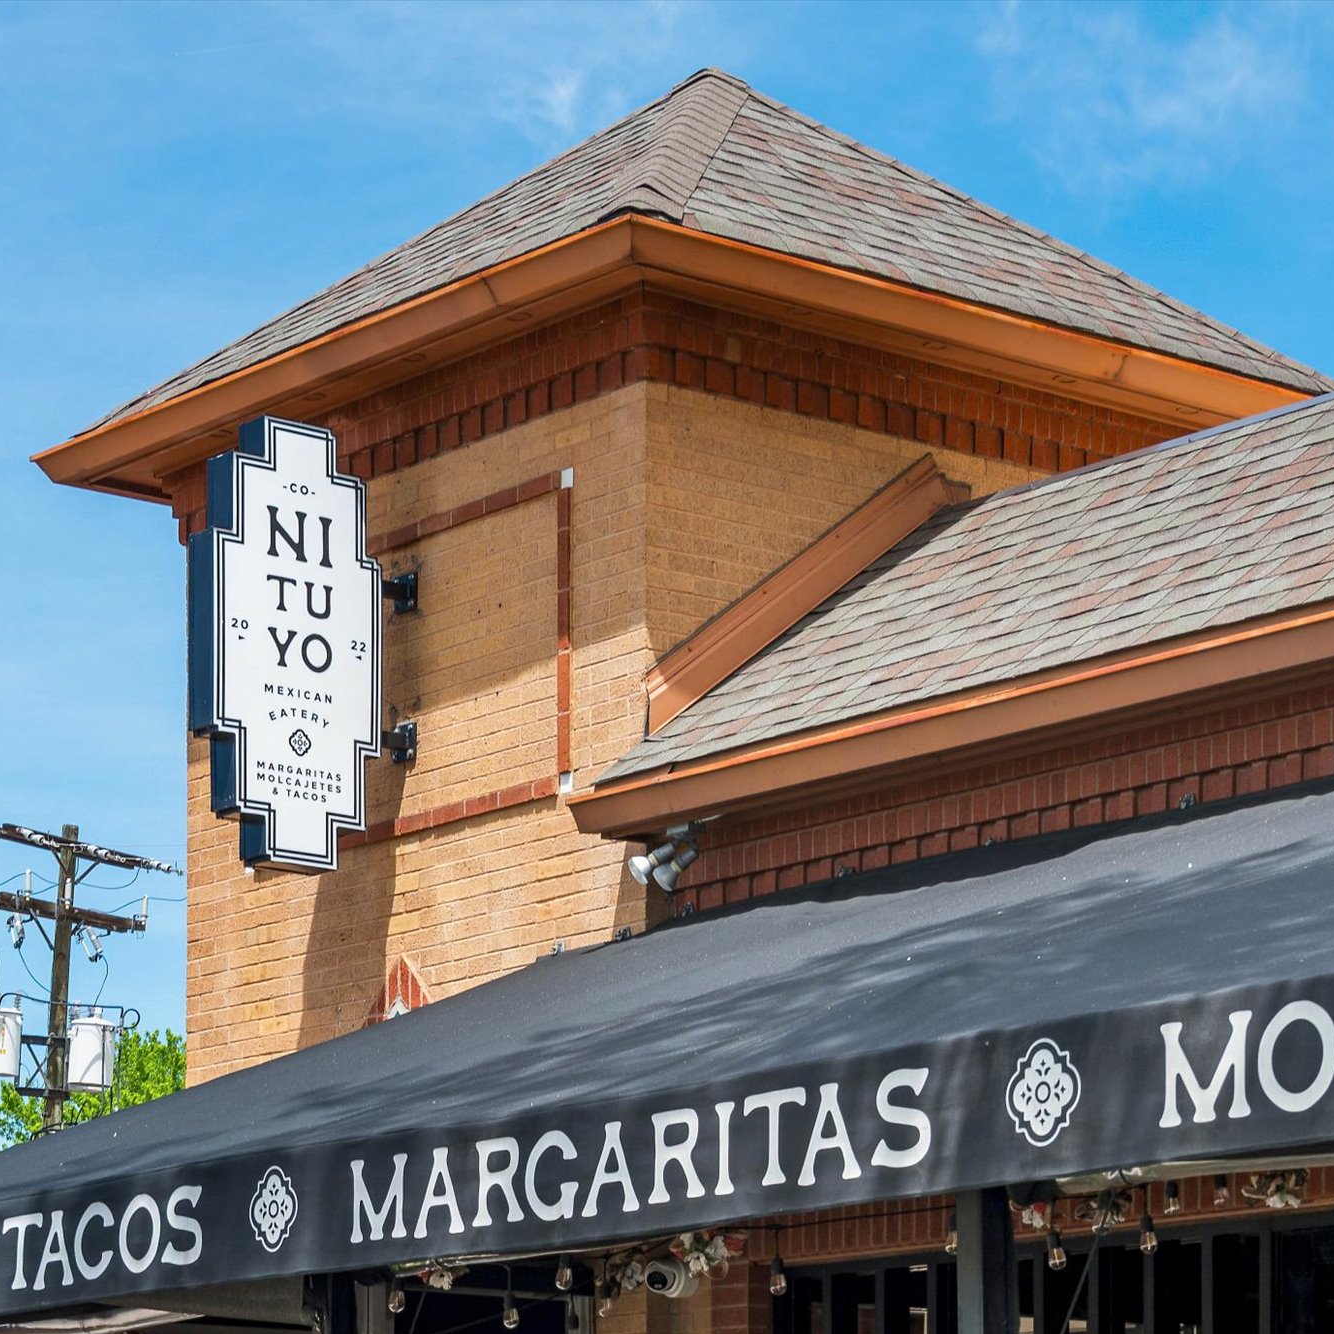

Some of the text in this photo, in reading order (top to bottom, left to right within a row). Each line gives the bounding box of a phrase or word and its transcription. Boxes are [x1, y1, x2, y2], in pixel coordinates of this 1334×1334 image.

[266, 505, 332, 568] NI
[266, 574, 333, 620] TU
[231, 618, 249, 630] 20
[267, 626, 333, 674] YO
[351, 640, 367, 652] 22
[264, 683, 332, 704] MEXICAN
[268, 708, 329, 728] EATERY
[256, 760, 342, 782] MARGARITAS
[256, 772, 342, 794] MOLCAJETES
[272, 787, 327, 803] & TACOS
[2, 1185, 203, 1291] TACOS
[349, 1067, 933, 1244] MARGARITAS
